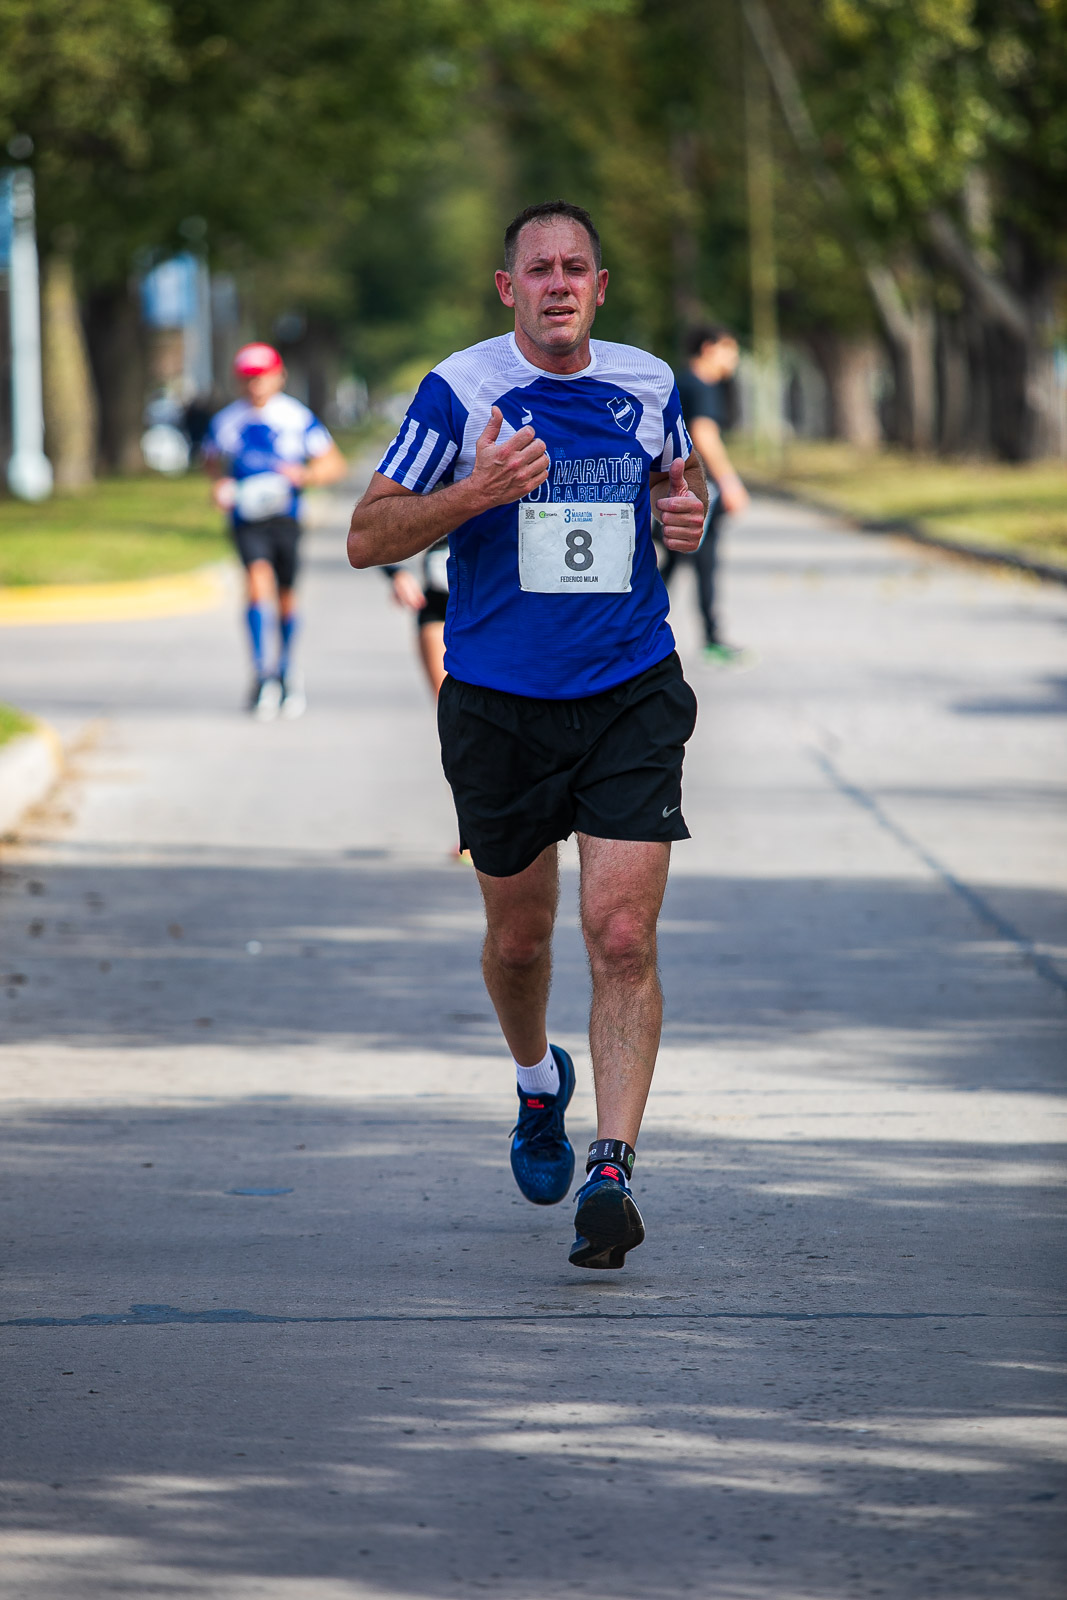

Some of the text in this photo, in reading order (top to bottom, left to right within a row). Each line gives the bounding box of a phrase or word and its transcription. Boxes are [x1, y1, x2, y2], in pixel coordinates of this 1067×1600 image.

[553, 452, 643, 485] MARATÓN
[564, 508, 571, 523] 3
[564, 529, 594, 572] 8
